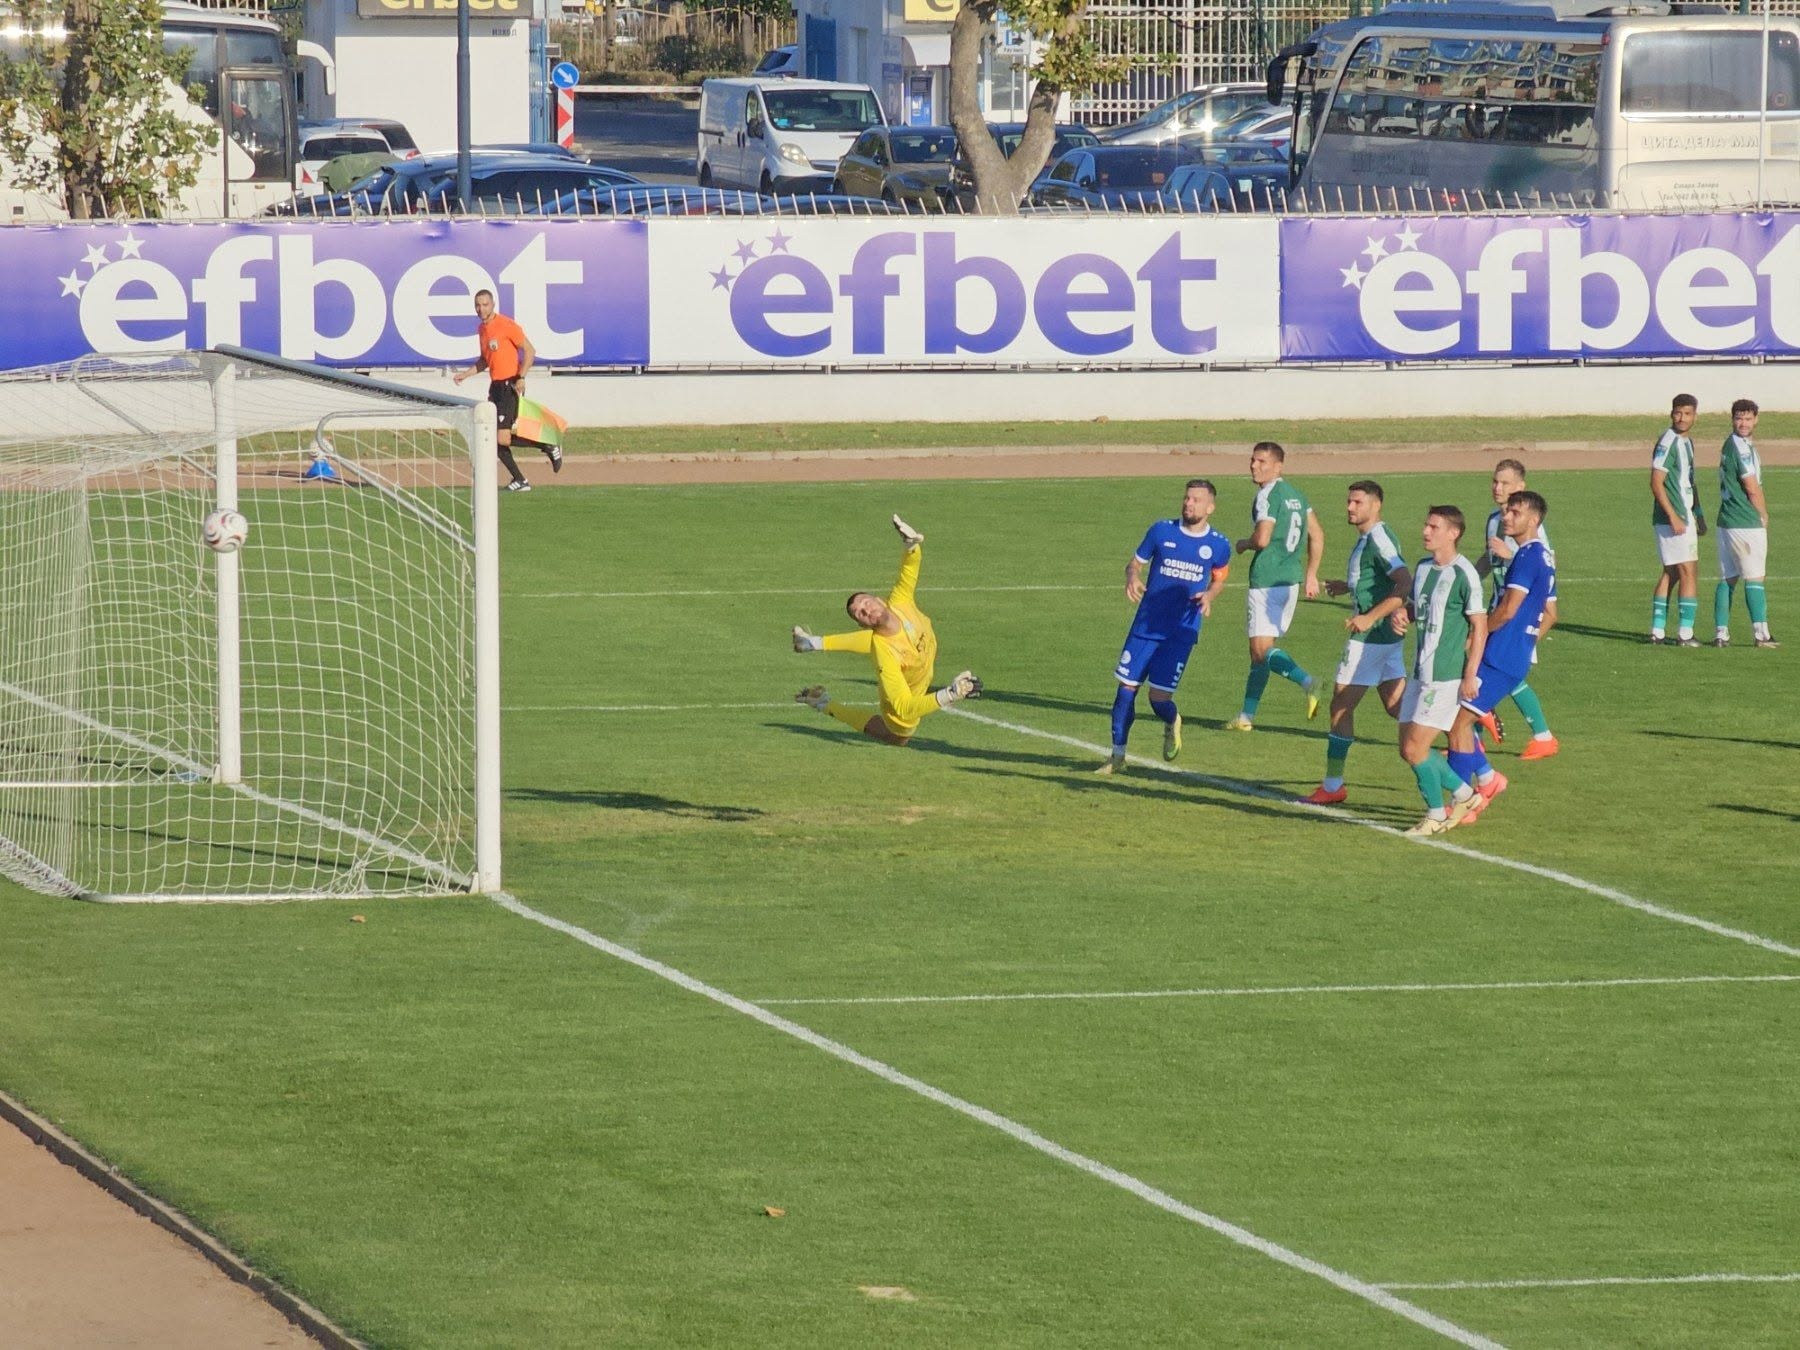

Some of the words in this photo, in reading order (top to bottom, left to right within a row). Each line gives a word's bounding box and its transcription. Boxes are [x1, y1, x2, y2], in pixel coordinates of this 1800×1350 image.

[79, 231, 584, 365] efbet
[729, 230, 1218, 357] efbet
[1285, 511, 1302, 553] 6
[1160, 565, 1204, 582] НЕСЕБЪР
[1163, 558, 1204, 574] ОБЩИНА
